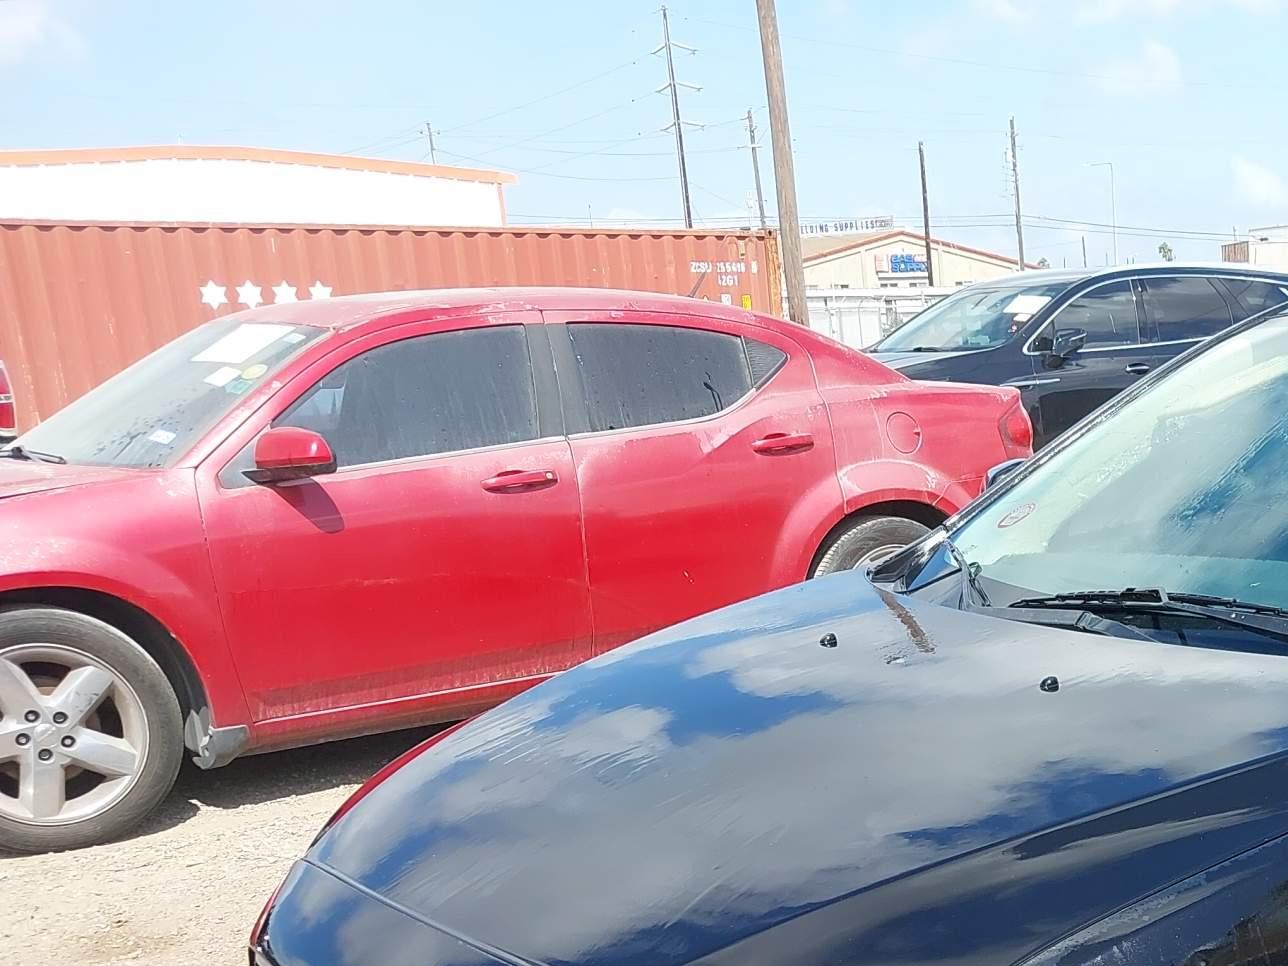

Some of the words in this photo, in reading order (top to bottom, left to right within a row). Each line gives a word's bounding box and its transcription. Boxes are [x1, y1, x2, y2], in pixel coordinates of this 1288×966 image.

[800, 223, 829, 235] ELDING
[833, 219, 876, 232] SUPPLIES
[690, 261, 713, 273] ZCSU
